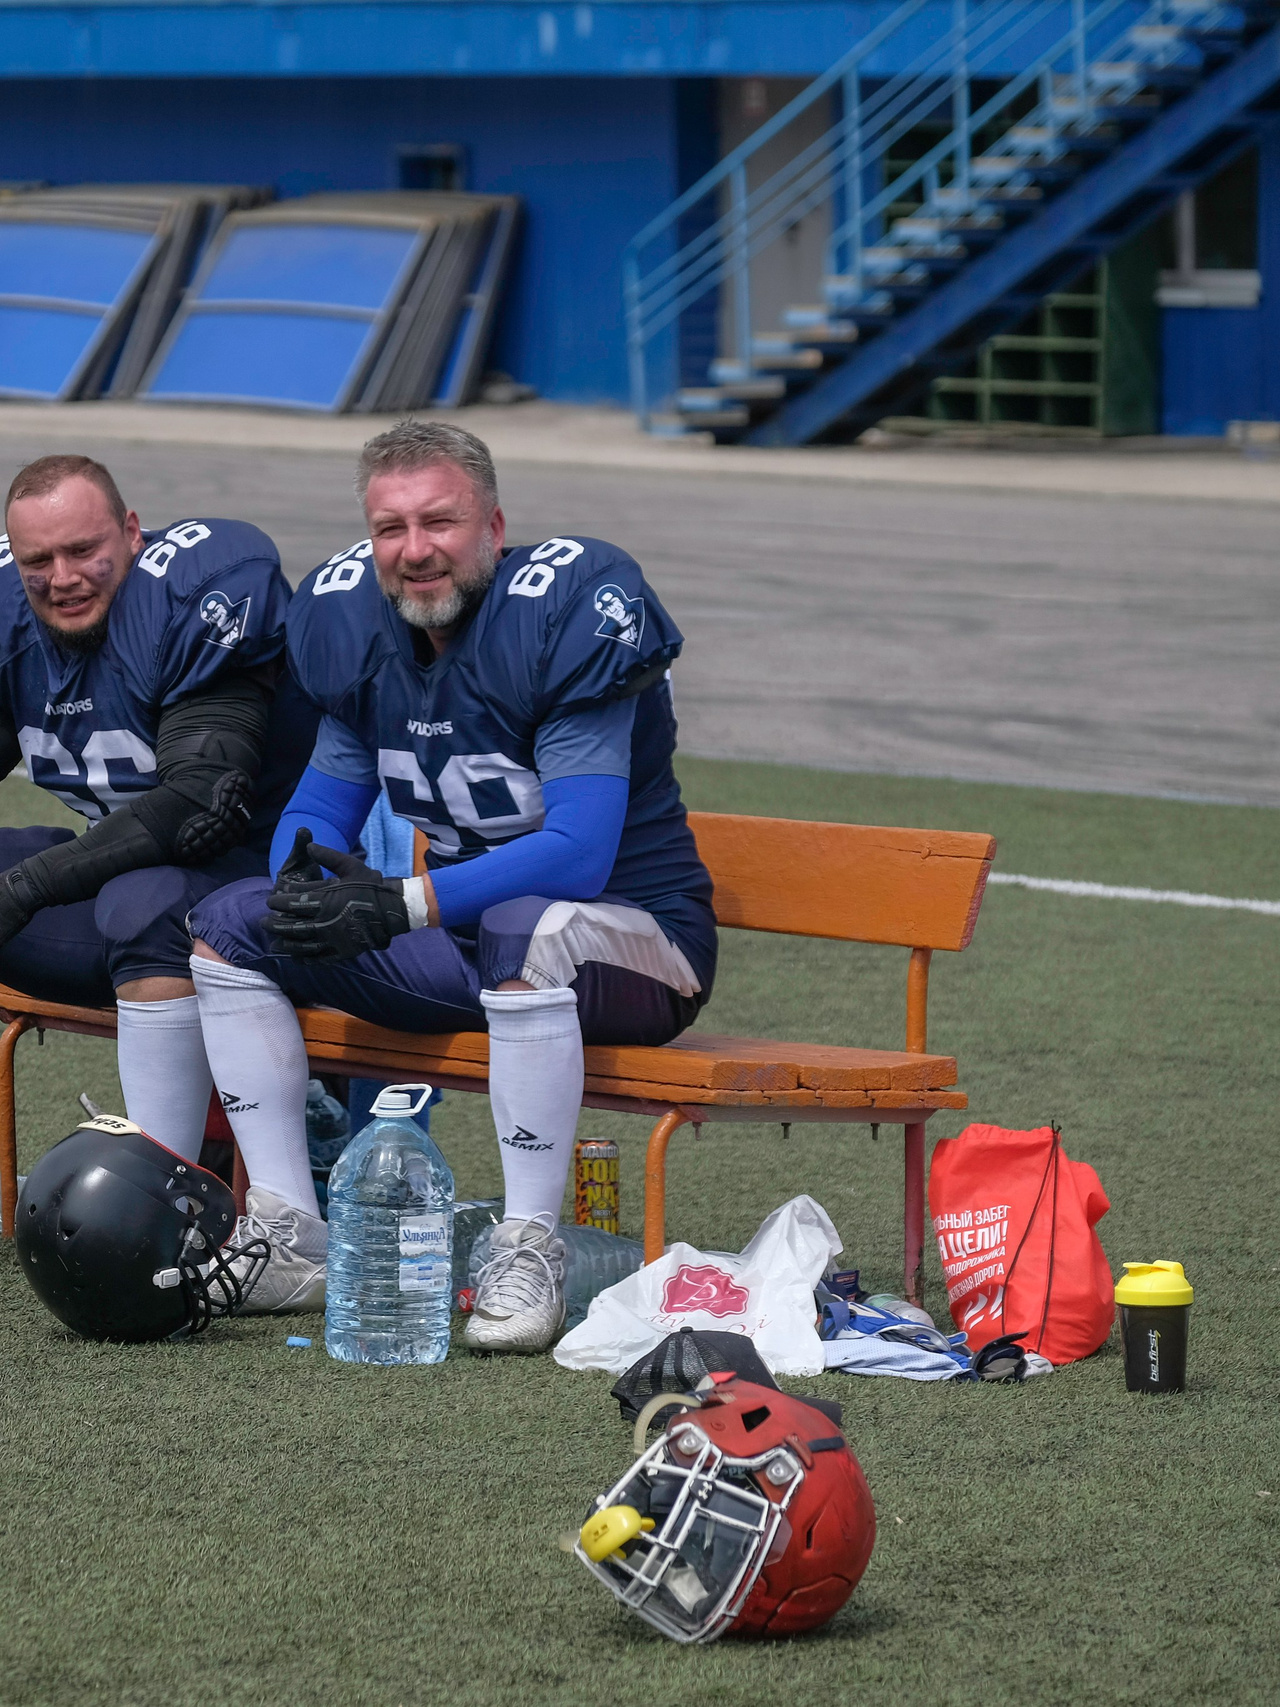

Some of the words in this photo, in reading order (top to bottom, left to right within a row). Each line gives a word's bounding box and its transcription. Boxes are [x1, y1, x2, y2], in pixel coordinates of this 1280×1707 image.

[138, 521, 212, 578] 66
[312, 538, 373, 596] 69
[508, 538, 584, 597] 69
[223, 1102, 260, 1113] EMIX
[501, 1136, 555, 1151] DEMIX
[975, 1205, 1011, 1226] ЗАБЕГ
[939, 1235, 949, 1260] А
[948, 1221, 1008, 1258] ЦЕЛИ!
[974, 1263, 1005, 1287] ДОРОГА
